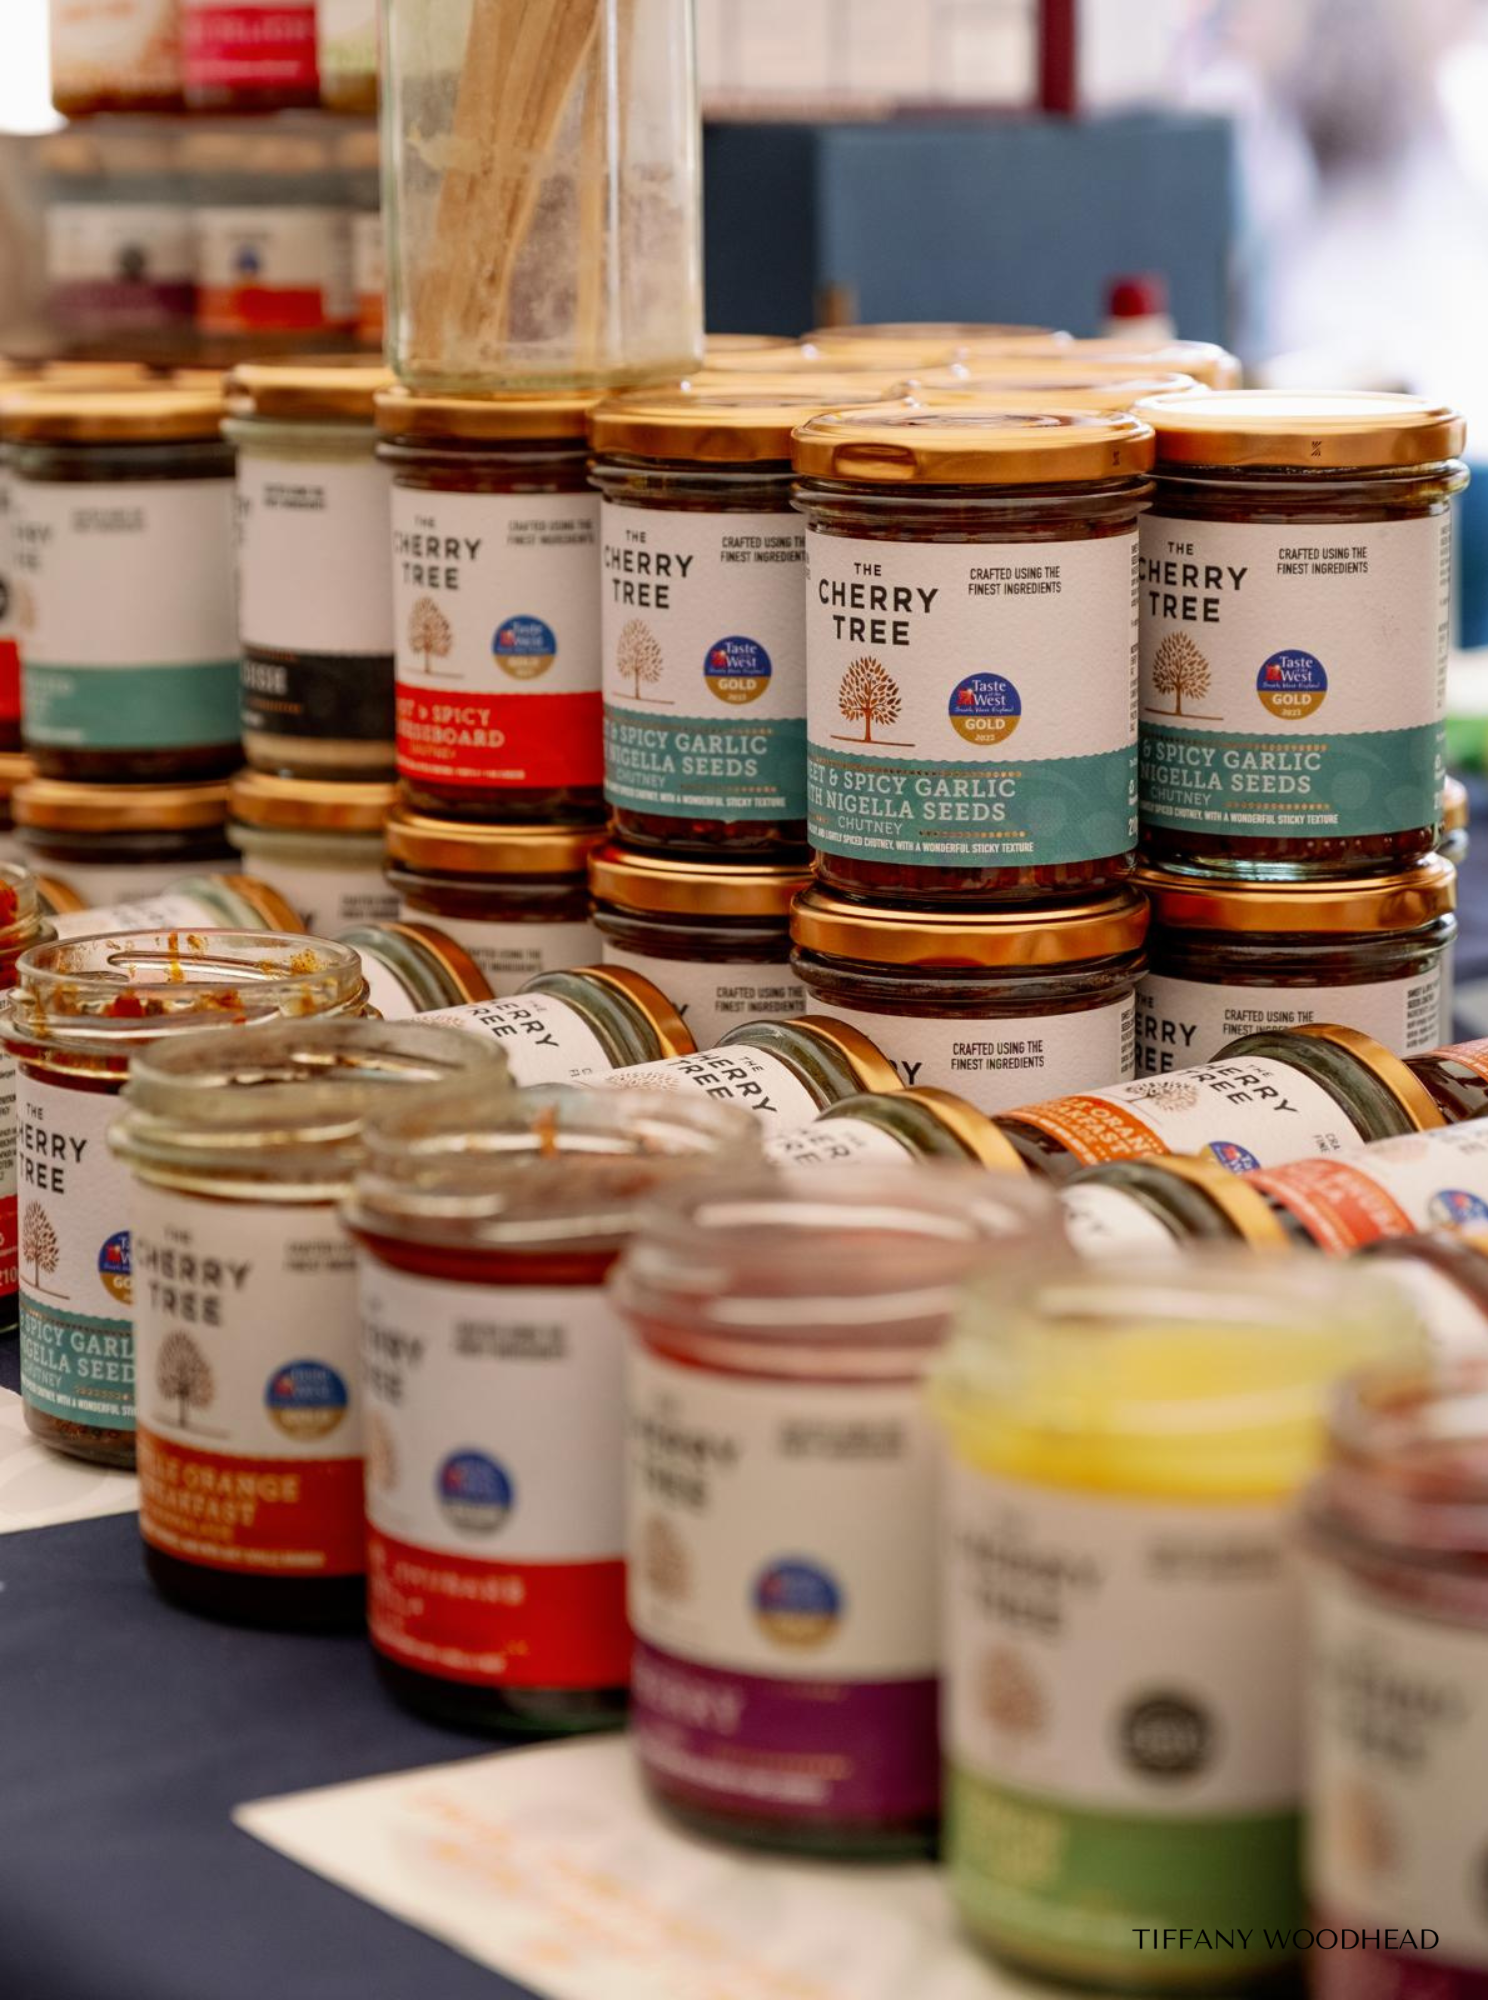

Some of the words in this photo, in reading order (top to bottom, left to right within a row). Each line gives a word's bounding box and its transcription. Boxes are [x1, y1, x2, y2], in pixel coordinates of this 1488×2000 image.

[625, 529, 647, 544] THE
[721, 536, 762, 548] CRAFTED
[764, 536, 791, 548] USING
[720, 551, 751, 562] FINEST
[754, 551, 806, 563] INGREDIENT
[1168, 541, 1194, 555] THE
[1278, 547, 1320, 560] CRAFTED
[1322, 546, 1349, 560] USING
[1352, 546, 1368, 559] THE
[605, 545, 694, 578] CHERRY
[854, 563, 882, 577] THE
[1277, 562, 1309, 575] FINEST
[1311, 561, 1369, 574] INGREDIENTS
[402, 562, 460, 590] TREE
[970, 566, 1012, 580] CRAFTED
[1014, 566, 1042, 580] USING
[1044, 565, 1061, 578] THE
[612, 578, 670, 609] TREE
[818, 578, 939, 613] CHERRY
[968, 582, 1001, 595] FINEST
[1003, 580, 1062, 595] INGREDIENTS
[1149, 591, 1220, 622] TREE
[833, 615, 910, 646] TREE
[1279, 655, 1314, 669] Taste
[718, 678, 757, 690] GOLD
[971, 679, 1007, 692] Taste
[1280, 669, 1312, 682] West
[974, 694, 1006, 706] West
[1272, 693, 1312, 706] GOLD
[432, 703, 491, 727] SPICY
[965, 718, 1006, 730] GOLD
[620, 724, 669, 750] SPICY
[675, 732, 768, 755] GARLIC
[682, 755, 758, 777] SEEDS
[1156, 741, 1216, 767] SPICY
[1223, 750, 1322, 771] GARLIC
[829, 768, 839, 787] &
[844, 770, 907, 796] SPICY
[915, 778, 1016, 798] GARLIC
[1140, 761, 1224, 791] NIGELLA
[1231, 774, 1311, 794] SEEDS
[826, 789, 915, 819] NIGELLA
[923, 801, 1006, 821] SEEDS
[1151, 785, 1212, 807] CHUTNEY
[838, 815, 903, 836] CHUTNEY
[1277, 814, 1305, 824] STICKY
[1307, 814, 1339, 824] TEXTURE
[896, 840, 914, 851] WITH
[922, 841, 970, 854] WONDERFUL
[971, 842, 1000, 853] STICKY
[1001, 842, 1034, 853] TEXTURE
[716, 986, 755, 998] CRAFTED
[468, 1008, 518, 1038] REE
[493, 1002, 560, 1047] ERRY
[1224, 1009, 1264, 1022] CRAFTED
[1267, 1010, 1295, 1023] USING
[1297, 1010, 1315, 1022] THE
[1136, 1013, 1198, 1047] ERRY
[1223, 1023, 1252, 1036] FINEST
[953, 1042, 994, 1056] CRAFTED
[997, 1041, 1026, 1055] USING
[1028, 1039, 1044, 1053] THE
[738, 1056, 764, 1072] THE
[951, 1058, 984, 1070] FINEST
[986, 1055, 1045, 1070] INGREDIENTS
[1248, 1064, 1275, 1078] THE
[668, 1060, 735, 1101] TREE
[697, 1053, 778, 1114] HERRY
[1180, 1069, 1254, 1105] TREE
[1206, 1064, 1299, 1114] HERRY
[26, 1102, 44, 1120] THE
[19, 1123, 88, 1163] HERRY
[19, 1152, 65, 1194] TREE
[148, 1280, 222, 1328] TREE
[70, 1331, 135, 1359] GARL
[77, 1357, 135, 1384] SEED
[181, 1463, 300, 1504] ORANGE
